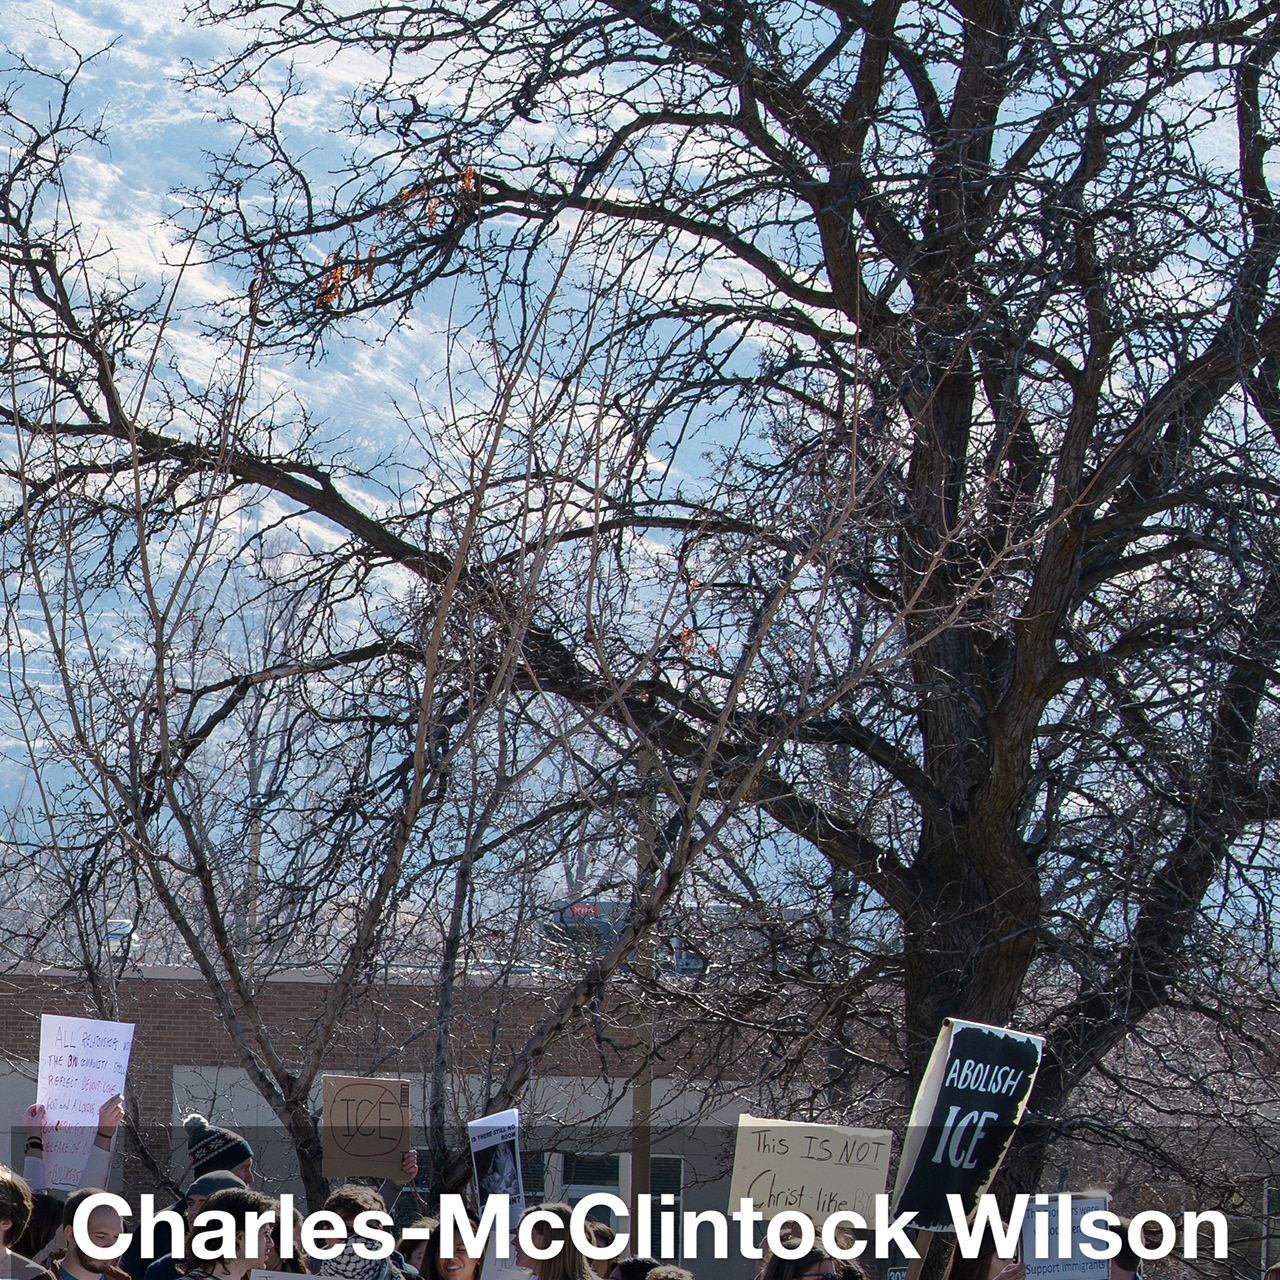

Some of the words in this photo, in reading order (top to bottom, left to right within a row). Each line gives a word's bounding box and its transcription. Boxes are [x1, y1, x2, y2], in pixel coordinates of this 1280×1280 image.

[55, 1026, 77, 1048] ALL
[48, 1054, 63, 1068] THE
[48, 1074, 79, 1088] REFLECT
[945, 1059, 1024, 1096] ABOLISH
[341, 1099, 397, 1141] ICE
[477, 1131, 492, 1141] THERE
[493, 1127, 506, 1136] STILL
[500, 1132, 515, 1141] ROOM
[932, 1106, 999, 1169] ICE
[751, 1130, 789, 1155] This
[800, 1136, 832, 1161] IS
[837, 1140, 886, 1164] NOT
[1026, 1263, 1060, 1276] Support
[1061, 1260, 1106, 1273] immigrants
